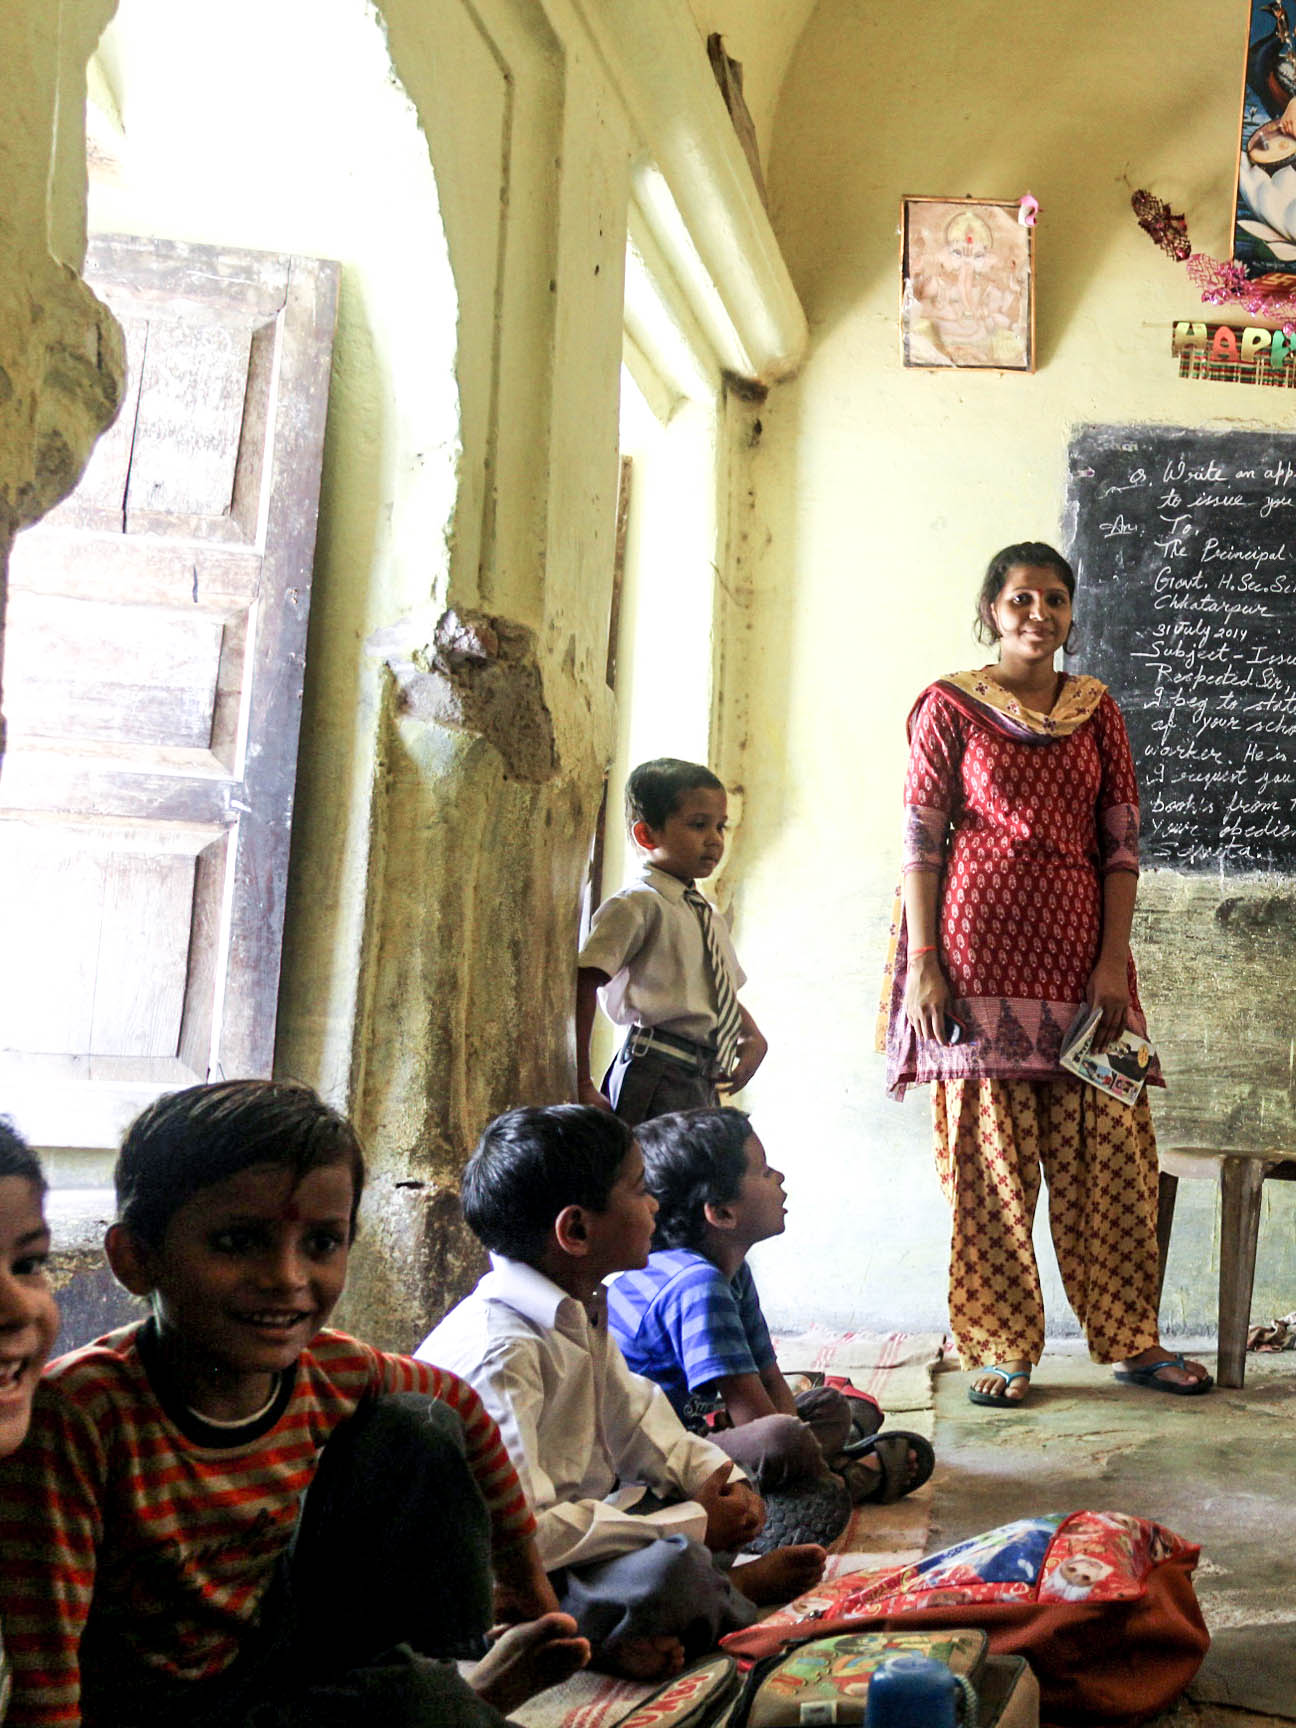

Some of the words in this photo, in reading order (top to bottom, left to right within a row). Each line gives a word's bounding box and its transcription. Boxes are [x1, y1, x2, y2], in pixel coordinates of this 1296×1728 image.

[1163, 458, 1226, 483] Write
[1235, 469, 1256, 480] an
[1157, 488, 1182, 508] to
[1187, 492, 1246, 507] issue
[1260, 494, 1294, 518] you
[1154, 539, 1188, 558] The
[1200, 537, 1287, 569] Principal
[1174, 619, 1211, 648] July
[1213, 628, 1248, 641] 2014
[1145, 663, 1253, 690] Respected
[1143, 687, 1165, 709] I
[1170, 688, 1209, 723] beg
[1216, 691, 1239, 710] to
[1152, 708, 1177, 745] of
[1196, 715, 1242, 737] your
[1243, 744, 1264, 763] He
[1267, 747, 1287, 763] is
[1145, 763, 1165, 785] I
[1255, 770, 1295, 795] you
[1222, 791, 1281, 824] from
